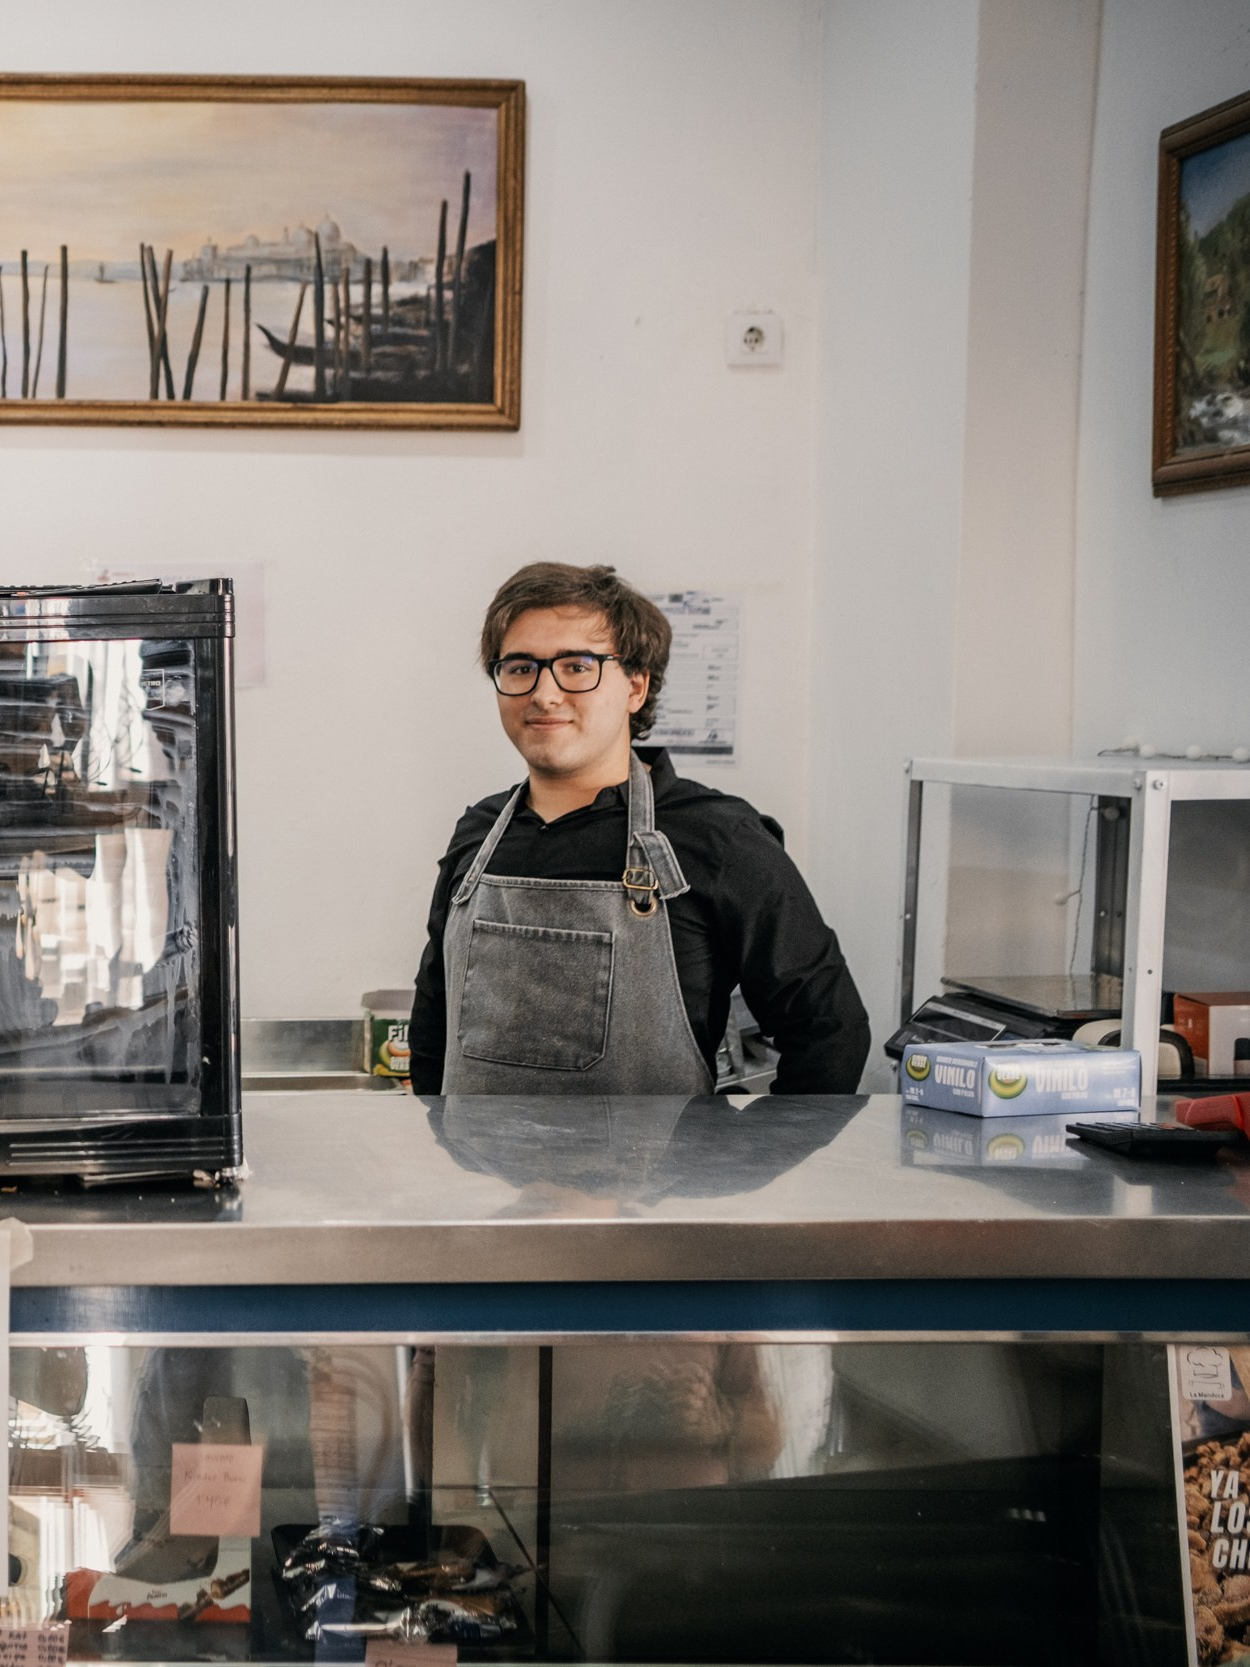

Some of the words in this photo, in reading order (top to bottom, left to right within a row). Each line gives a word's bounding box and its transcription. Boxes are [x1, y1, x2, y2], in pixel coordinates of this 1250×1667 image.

[388, 1025, 409, 1041] Fil
[935, 1064, 976, 1089] VINILO
[1035, 1067, 1088, 1093] VINILO
[1210, 1469, 1239, 1499] YA
[1210, 1501, 1250, 1534] LO
[1212, 1538, 1250, 1569] CH
